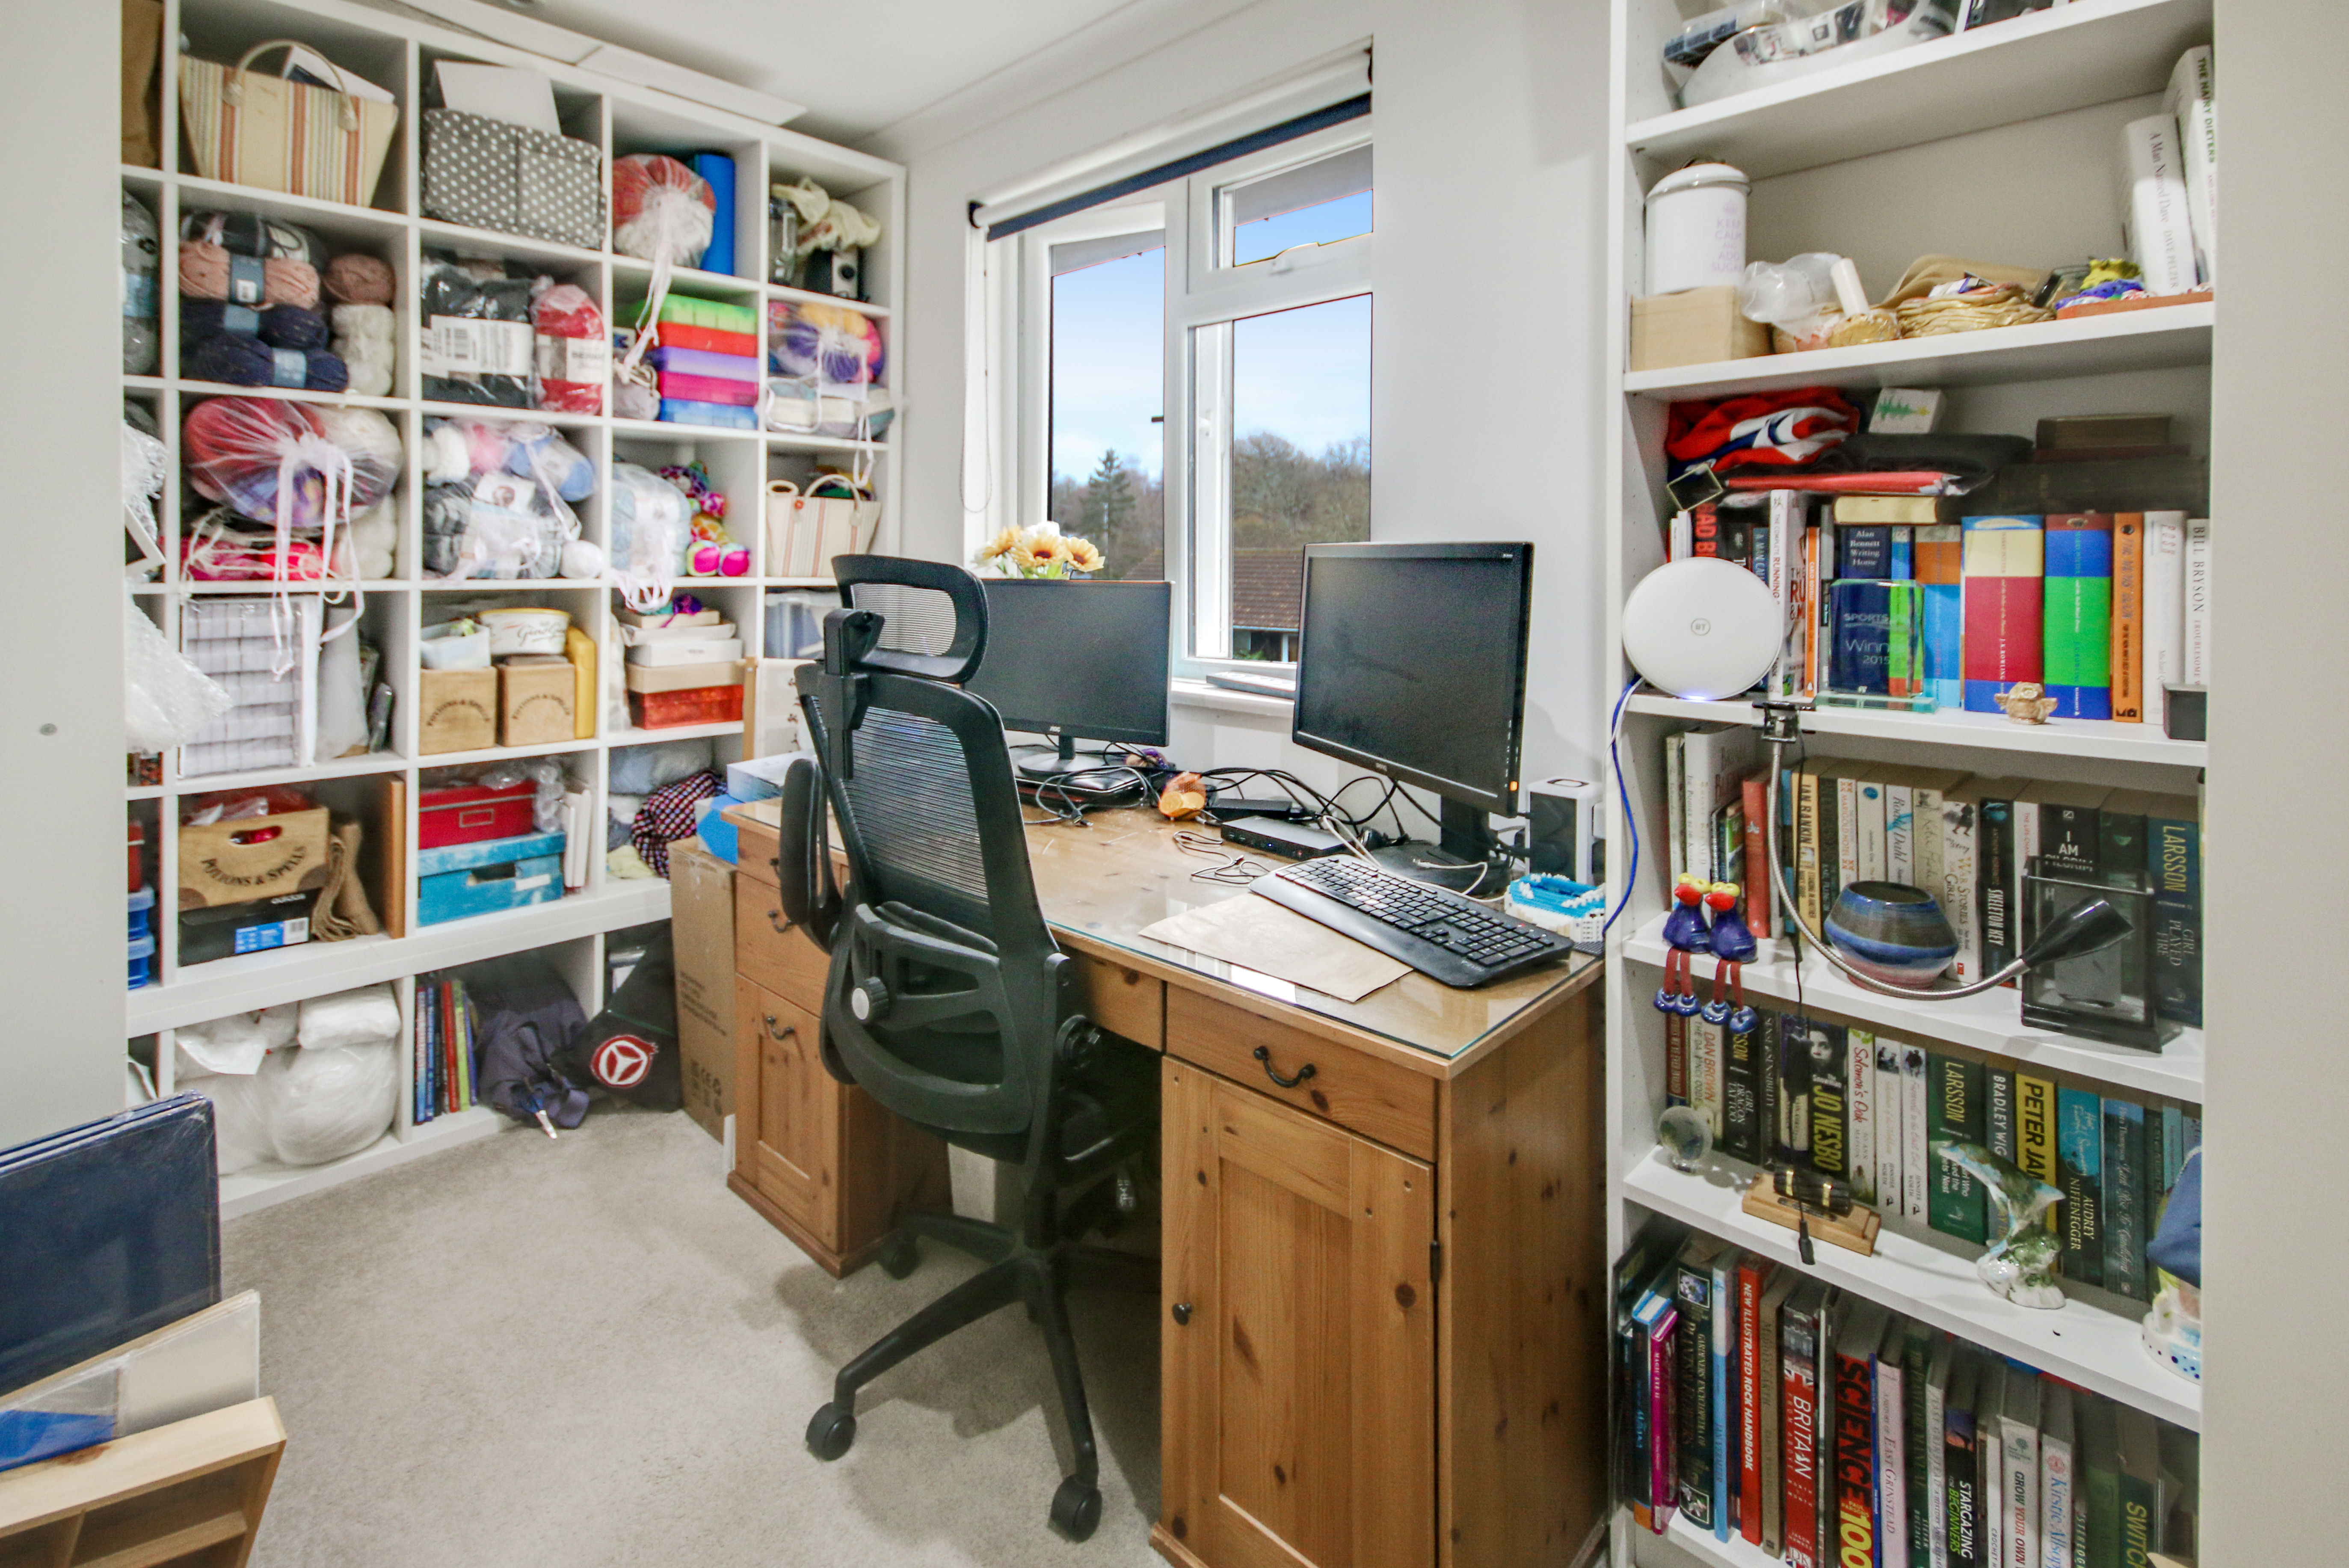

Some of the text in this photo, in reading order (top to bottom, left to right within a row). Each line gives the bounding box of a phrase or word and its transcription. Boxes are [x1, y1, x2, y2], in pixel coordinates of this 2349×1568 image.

[2198, 57, 2207, 80] THE
[1715, 231, 1742, 240] CALM
[1755, 542, 1764, 560] MAN
[1850, 549, 1880, 558] Writing
[2193, 527, 2204, 554] BILL
[1772, 557, 1780, 598] RUNNING
[2193, 562, 2205, 612] BRYSON
[1800, 785, 1812, 844] IAN RANKIN
[1893, 797, 1907, 863] Roald Dahl
[2059, 843, 2079, 856] AM
[2067, 831, 2071, 842] I
[201, 846, 306, 886] POTIONS & SPELLS
[2163, 826, 2187, 892] LARSSON
[1945, 874, 1958, 903] GIRLS
[1958, 886, 1970, 925] STORIES
[1988, 889, 2004, 946] SKELETON KEY
[2156, 932, 2169, 957] FIRE
[2169, 919, 2182, 966] PLAYED
[2182, 929, 2195, 956] GIRL
[1694, 1021, 1703, 1036] THE
[1704, 1032, 1715, 1102] DAN BROWN
[1764, 1018, 1774, 1107] SENSE SENSIBILITY
[1728, 1082, 1737, 1122] TATTOO
[1737, 1084, 1745, 1124] DRAGON
[1745, 1090, 1754, 1113] GIRL
[1813, 1085, 1842, 1112] JO
[1853, 1047, 1869, 1123] Solomon's Oak
[1945, 1061, 1965, 1123] LARSSON
[1993, 1075, 2007, 1129] BRADLEY
[2025, 1082, 2045, 1147] PETER
[1961, 1180, 1970, 1197] Who
[2070, 1177, 2081, 1250] NIFFENEGGER
[2083, 1195, 2094, 1239] AUDREY
[1744, 1283, 1754, 1472] NEW ILLUSTRATED ROCK HANDBOOK
[1793, 1396, 1812, 1479] BRITAIN
[1837, 1355, 1870, 1507] SCIENCE
[1884, 1437, 1896, 1467] EAST
[1885, 1469, 1897, 1534] GRINSTEAD
[2014, 1471, 2026, 1505] GROW
[2051, 1477, 2068, 1523] Kirstie
[1840, 1510, 1872, 1568] 100
[1948, 1488, 1961, 1555] BEGINNERS
[1959, 1481, 1973, 1559] STARGAZING
[2014, 1506, 2026, 1535] YOUR
[2015, 1538, 2026, 1564] OWN
